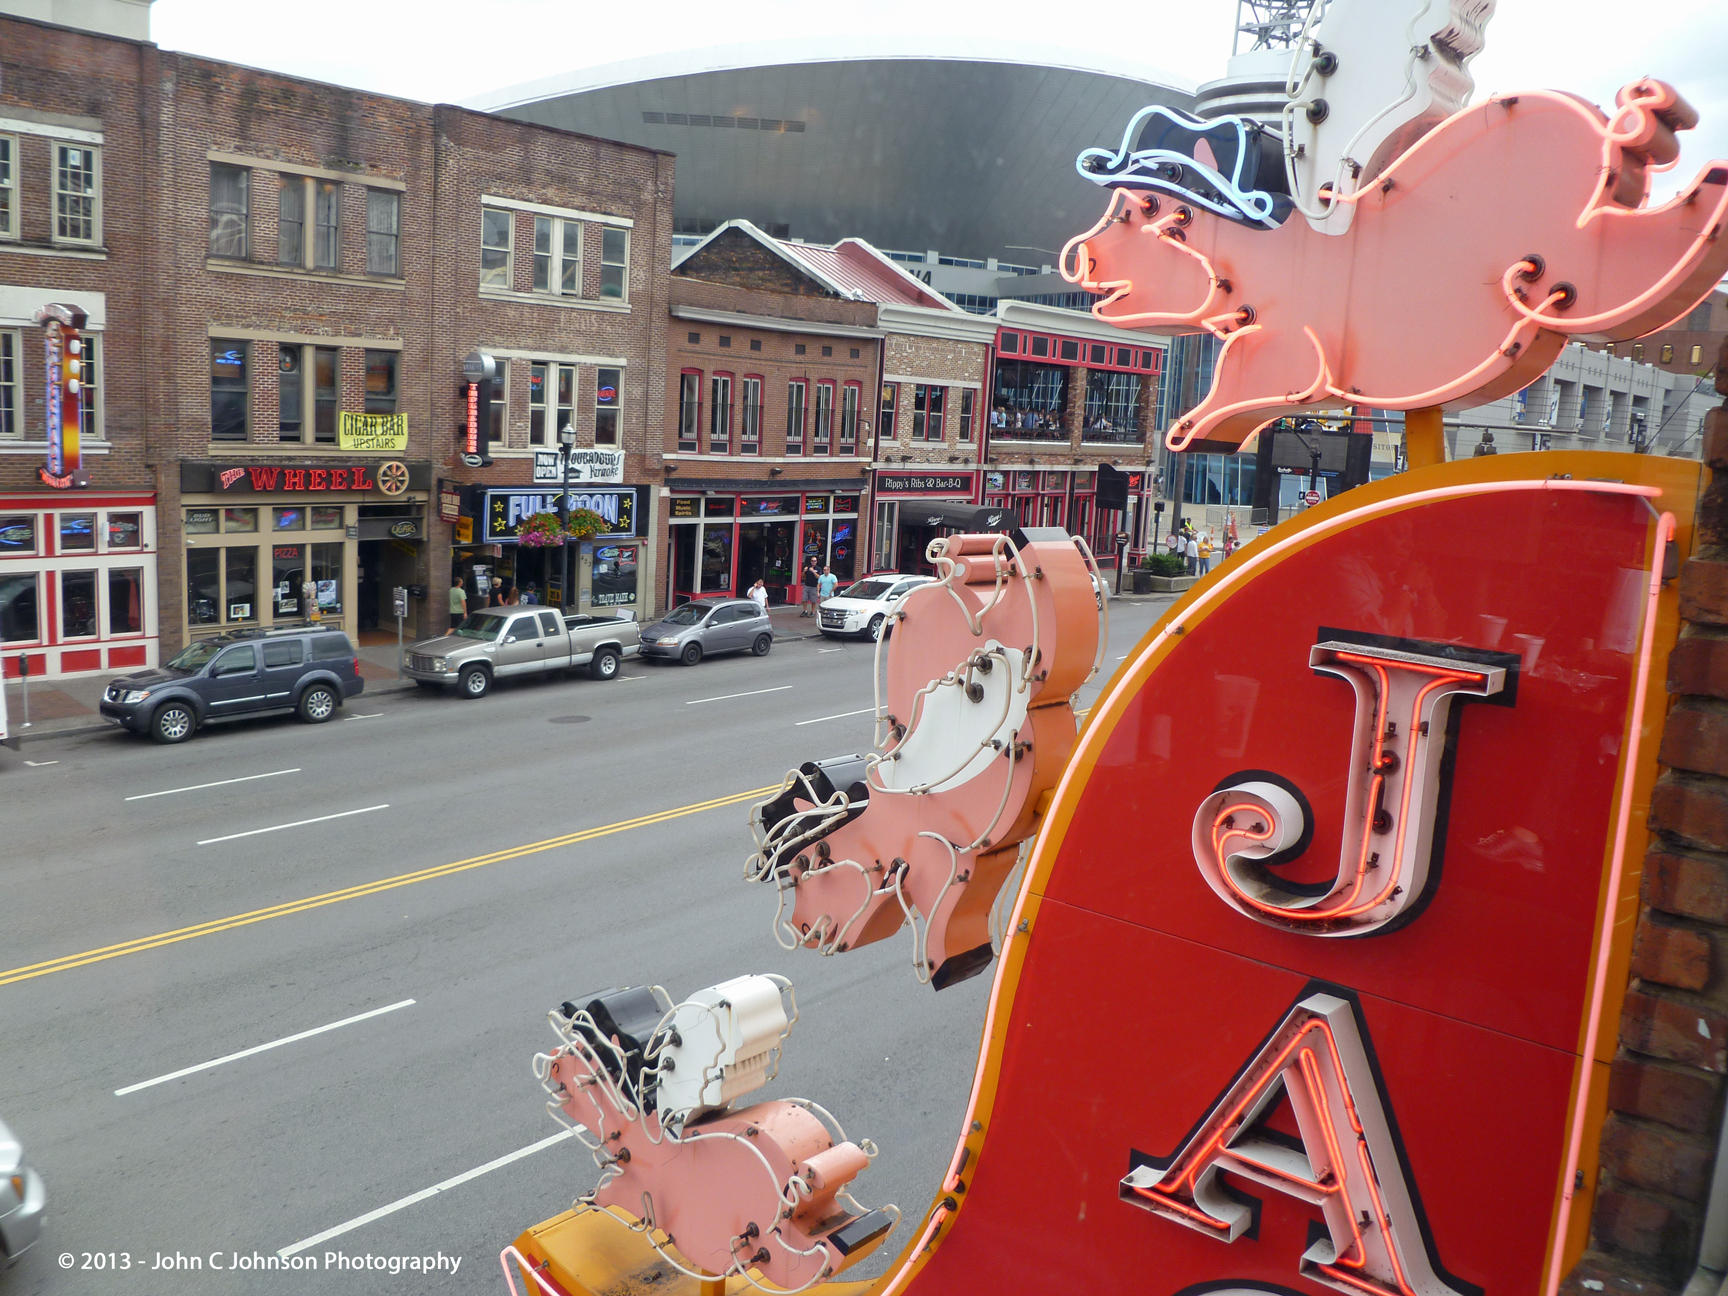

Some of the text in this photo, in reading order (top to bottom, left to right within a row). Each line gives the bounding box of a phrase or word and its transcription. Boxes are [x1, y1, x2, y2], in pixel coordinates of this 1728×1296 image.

[343, 413, 405, 437] CIGAR BAR
[353, 438, 396, 449] UPSTAIRS
[537, 454, 557, 465] NOW
[536, 466, 557, 477] OPEN
[220, 467, 373, 491] THE WHEEL
[885, 477, 909, 490] Rippy's
[910, 478, 925, 488] Ribs
[936, 477, 961, 489] Bar-B-Q
[509, 494, 559, 527] FULL
[391, 524, 416, 534] CIGARS
[274, 547, 299, 558] PIZZA
